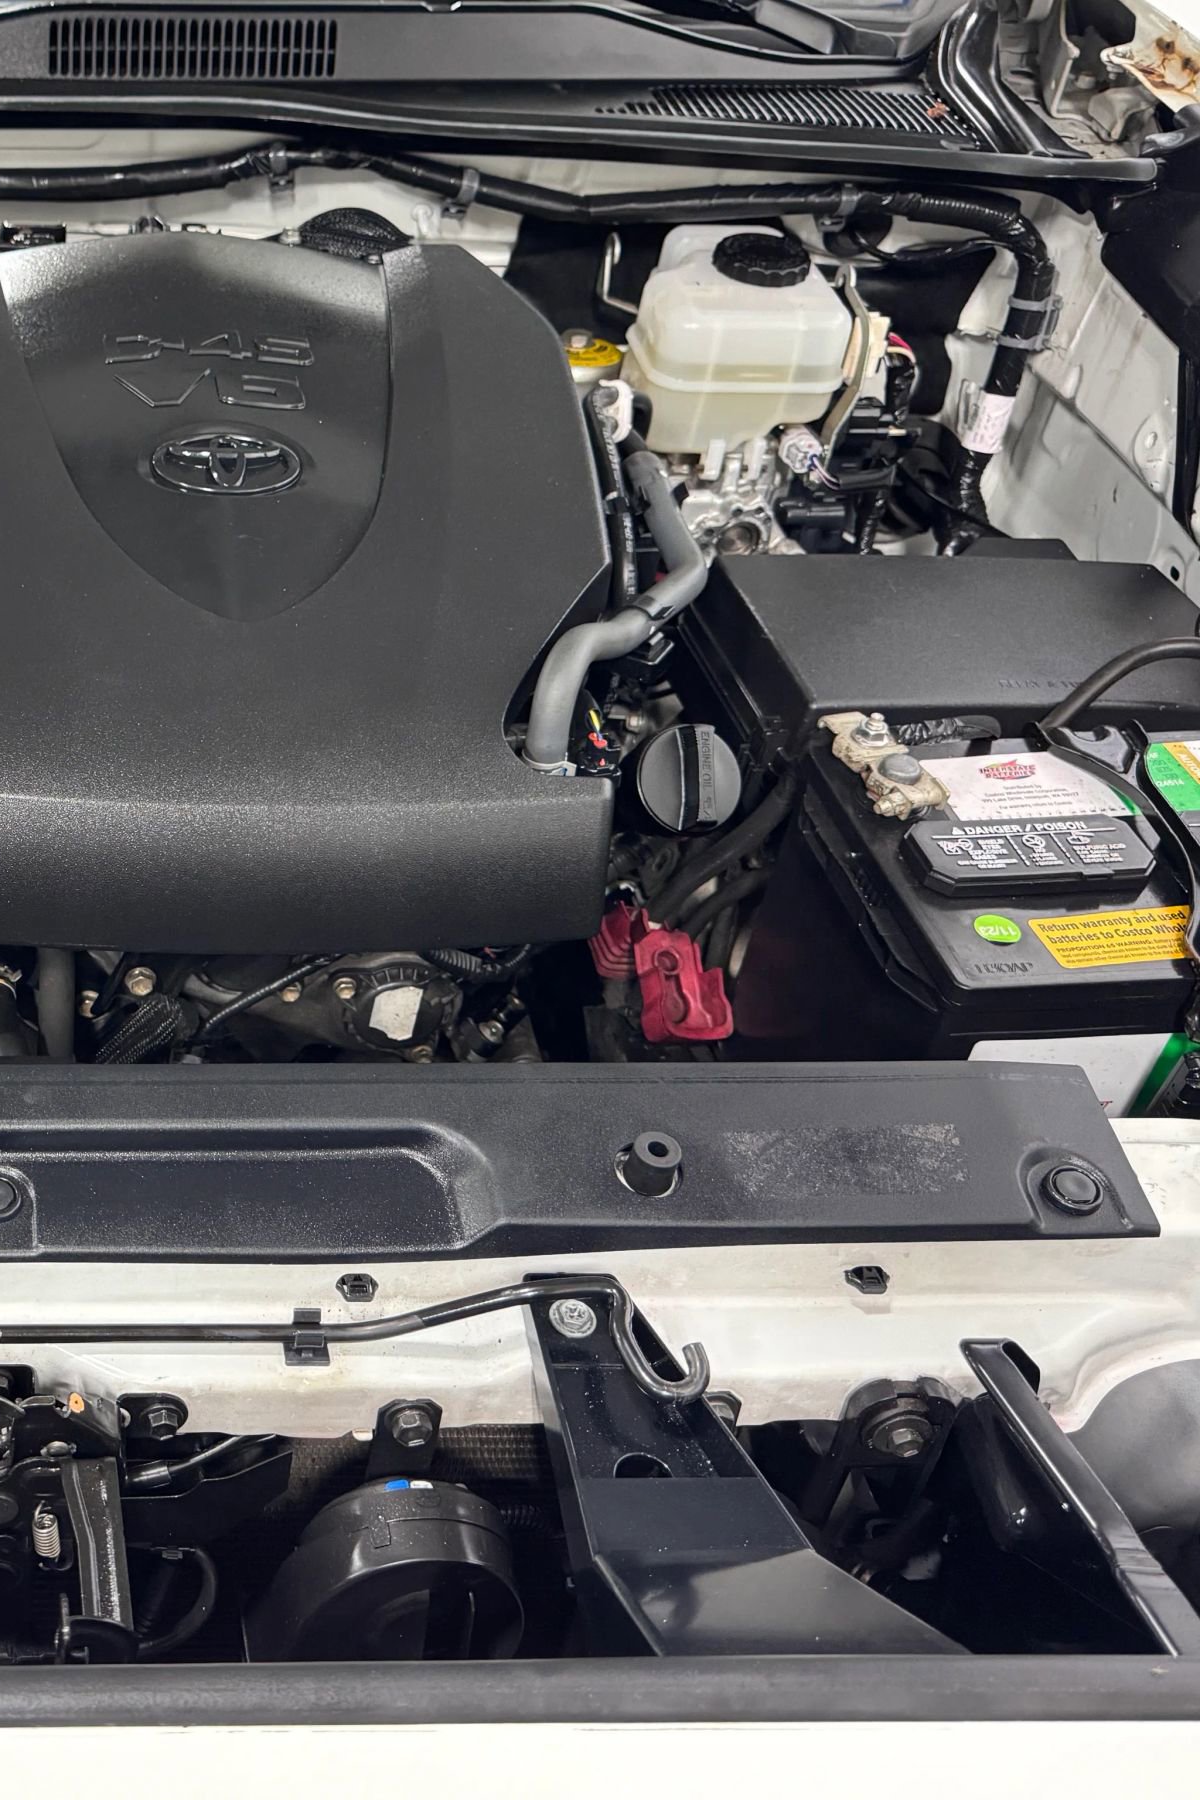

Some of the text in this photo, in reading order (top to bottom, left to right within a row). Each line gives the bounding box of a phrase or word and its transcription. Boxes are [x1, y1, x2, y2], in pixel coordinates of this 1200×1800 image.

[112, 368, 307, 410] V6
[700, 731, 713, 790] ENGINE OIL
[978, 764, 1036, 774] INTERSTATE
[984, 771, 1036, 779] BATTERIES
[964, 824, 1021, 835] DANGER
[1035, 821, 1087, 832] POISON
[1037, 909, 1186, 933] Return warranty and used
[1046, 931, 1100, 944] batteries
[1100, 929, 1114, 940] to
[1114, 926, 1153, 938] Costco
[1056, 943, 1106, 953] PROPOSITION
